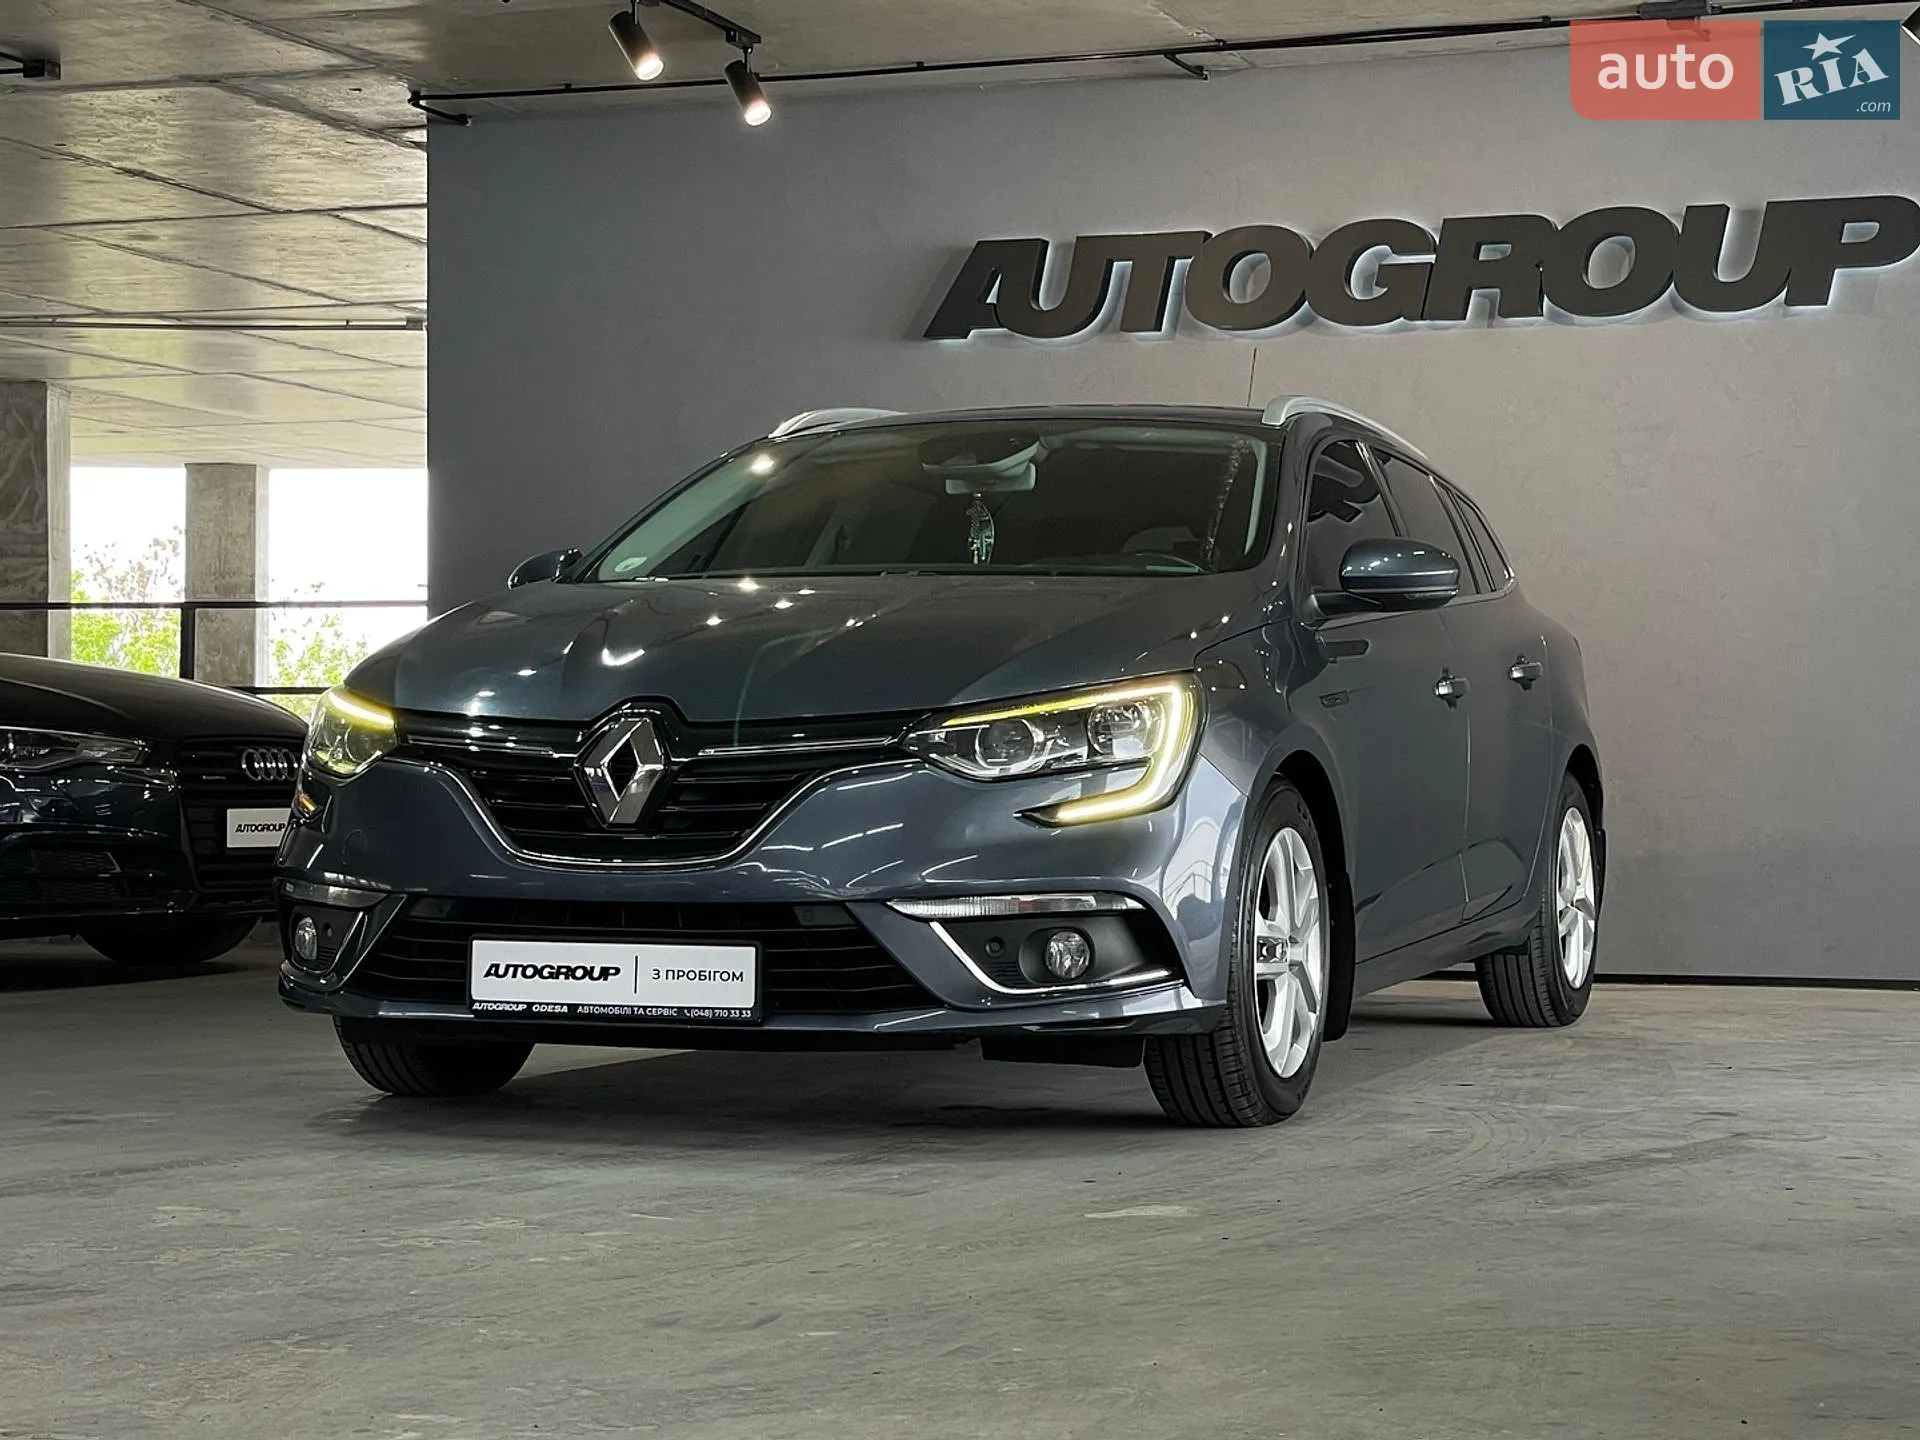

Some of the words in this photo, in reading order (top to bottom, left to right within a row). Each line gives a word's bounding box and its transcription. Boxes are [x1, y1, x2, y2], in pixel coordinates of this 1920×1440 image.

[924, 195, 1920, 341] AUTOGROUP
[235, 823, 286, 832] AUTOGROUP
[483, 963, 621, 982] AUTOGROUP
[665, 969, 745, 983] ПРОБІГОМ
[472, 1002, 528, 1012] AUTOGROUP
[532, 1003, 569, 1013] ODESA
[577, 1005, 632, 1015] АВТОМОБІЛІ
[646, 1008, 678, 1016] СЕРВІС
[691, 1008, 713, 1018] (048)
[714, 1009, 729, 1018] 710
[730, 1009, 740, 1018] 33
[741, 1009, 752, 1018] 33
